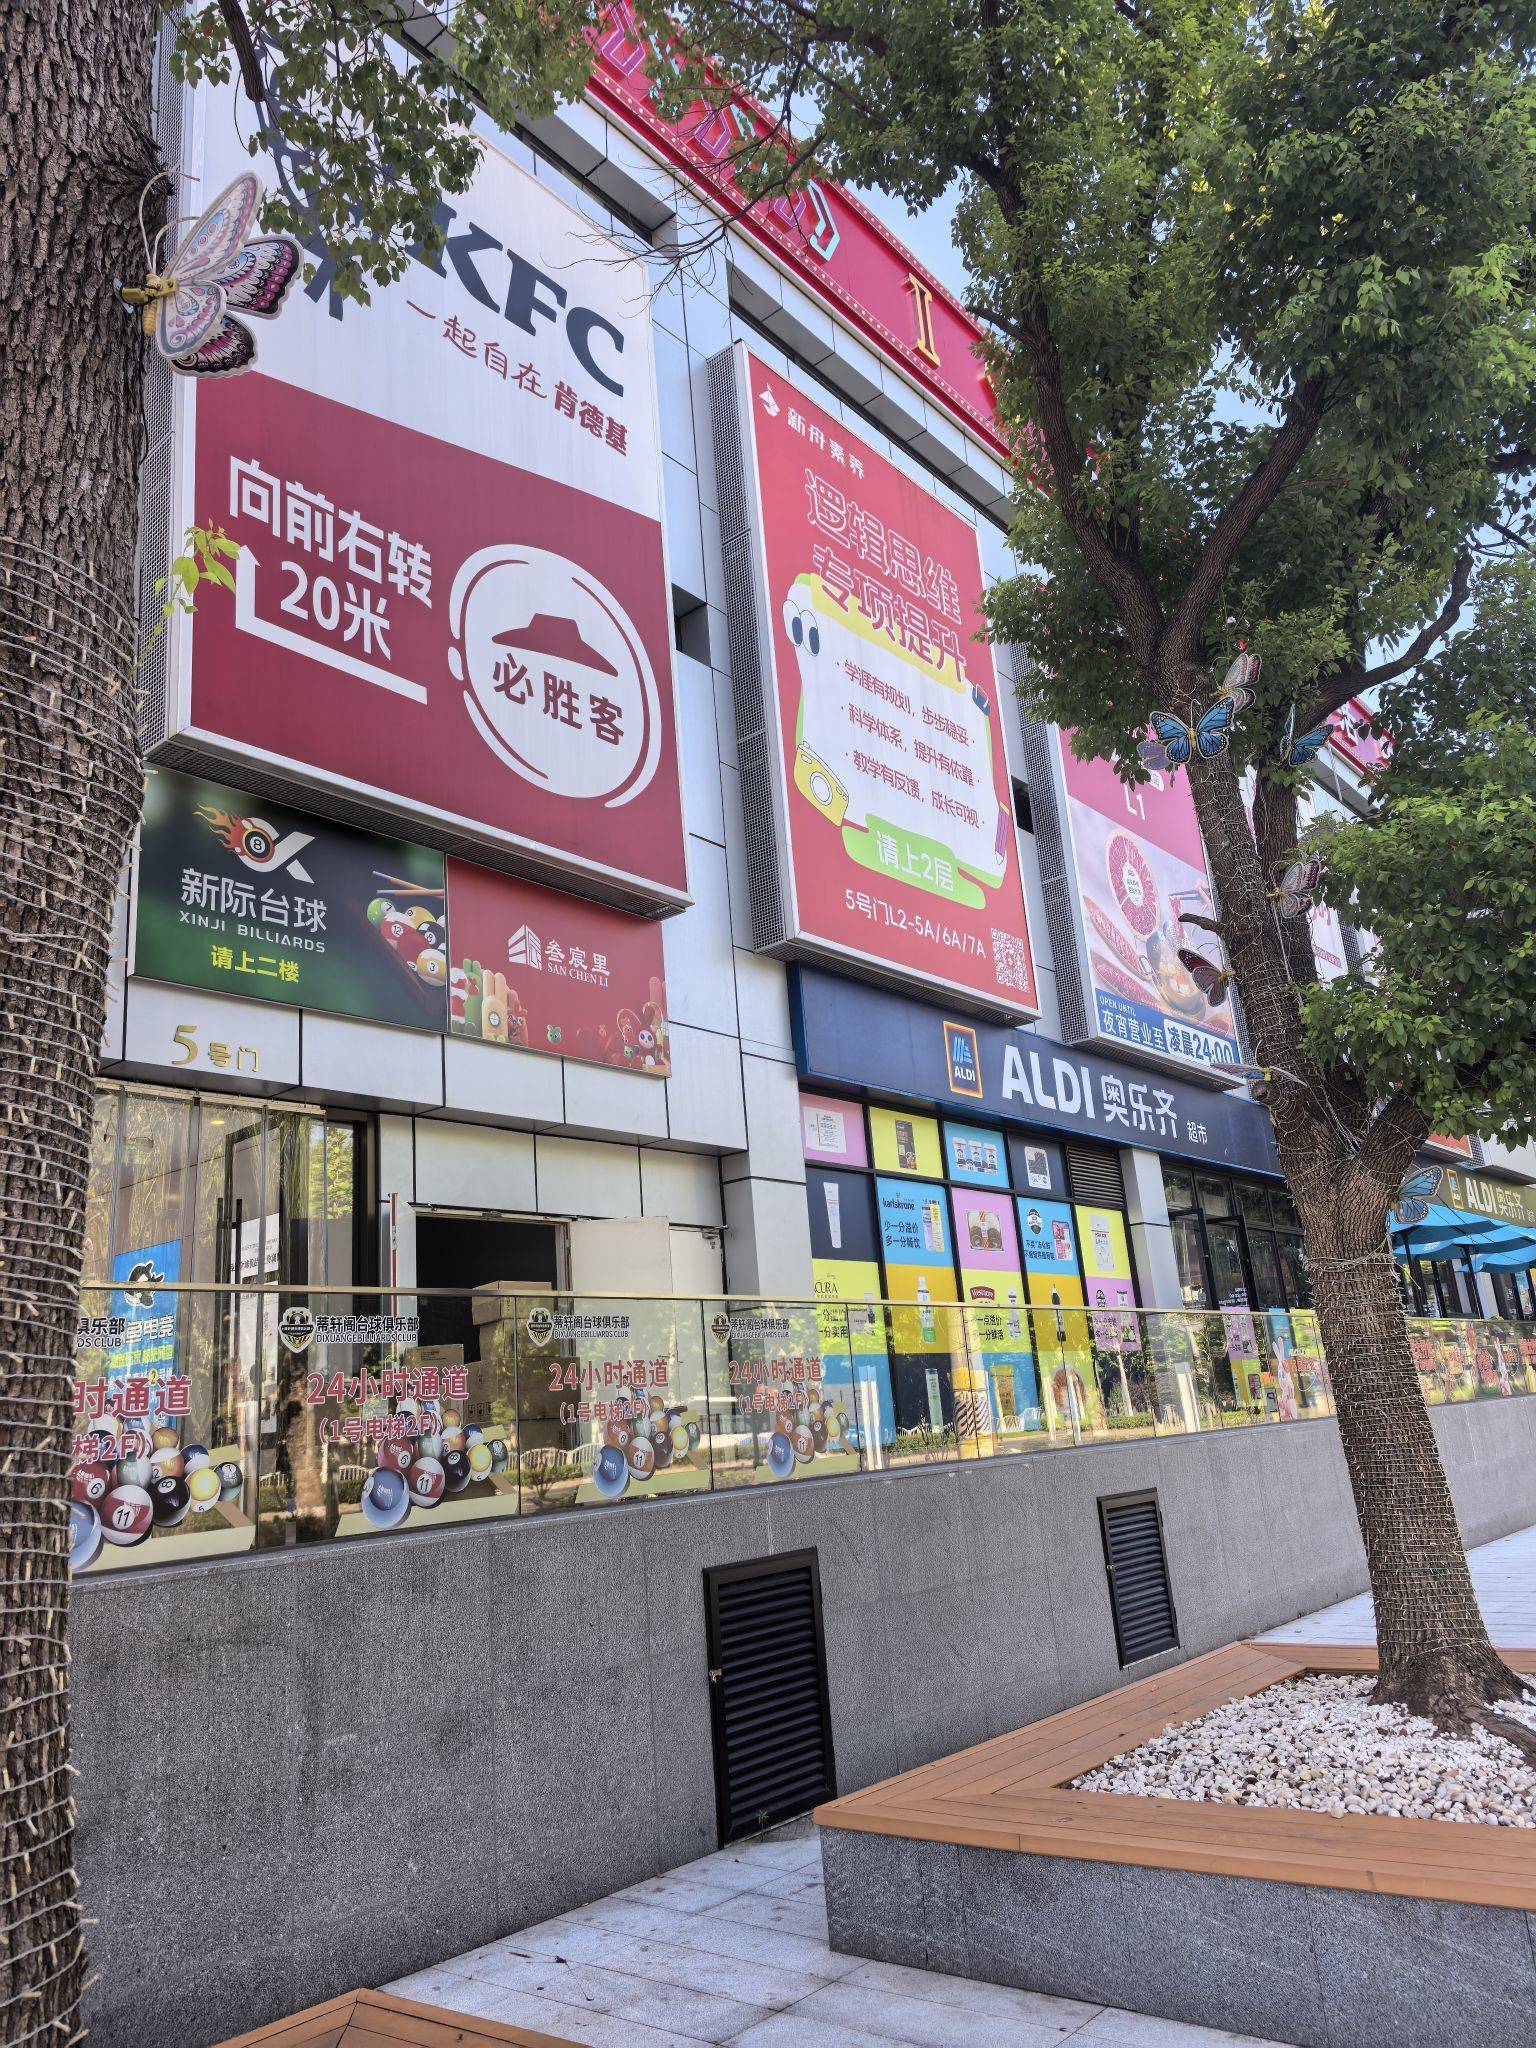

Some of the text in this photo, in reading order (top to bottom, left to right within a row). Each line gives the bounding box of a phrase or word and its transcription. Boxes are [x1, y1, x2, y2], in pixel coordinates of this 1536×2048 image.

[406, 299, 629, 458] 一起自在 肯德基
[229, 455, 433, 611] 向前右转
[805, 467, 962, 625] 逻辑思维
[279, 559, 391, 661] 20米
[812, 544, 967, 683] 专项提升
[493, 652, 625, 747] 必胜客
[876, 829, 955, 893] 请上2层
[180, 867, 328, 934] 新际台球
[178, 910, 327, 953] XINJI BILLIARDS
[844, 888, 988, 960] 5号门L2-5A/6A/7A
[210, 944, 301, 984] 请上二楼
[547, 962, 609, 987] SAN CHEN LI
[1099, 995, 1118, 1010] OPEN
[171, 1024, 260, 1073] 5号门
[1102, 1008, 1166, 1051] 夜宵营业至
[954, 1064, 976, 1082] ALDI
[1002, 1043, 1208, 1146] ALDI 奥乐齐 超市
[1465, 1177, 1498, 1215] ALDI
[316, 1315, 420, 1332] 蒂轩阁台球俱乐部
[397, 1333, 417, 1342] CLUB
[554, 1315, 630, 1329] 蒂轩阁台球俱乐部
[613, 1329, 629, 1338] CLUB
[94, 1337, 122, 1348] CLUB
[306, 1364, 469, 1406] 24小时通道
[548, 1358, 669, 1392] 24小时通道
[729, 1356, 823, 1384] 24小时通道
[319, 1412, 438, 1445] (1号电梯2F)
[90, 1482, 103, 1496] 6
[420, 1477, 430, 1492] 11
[116, 1508, 131, 1527] 11
